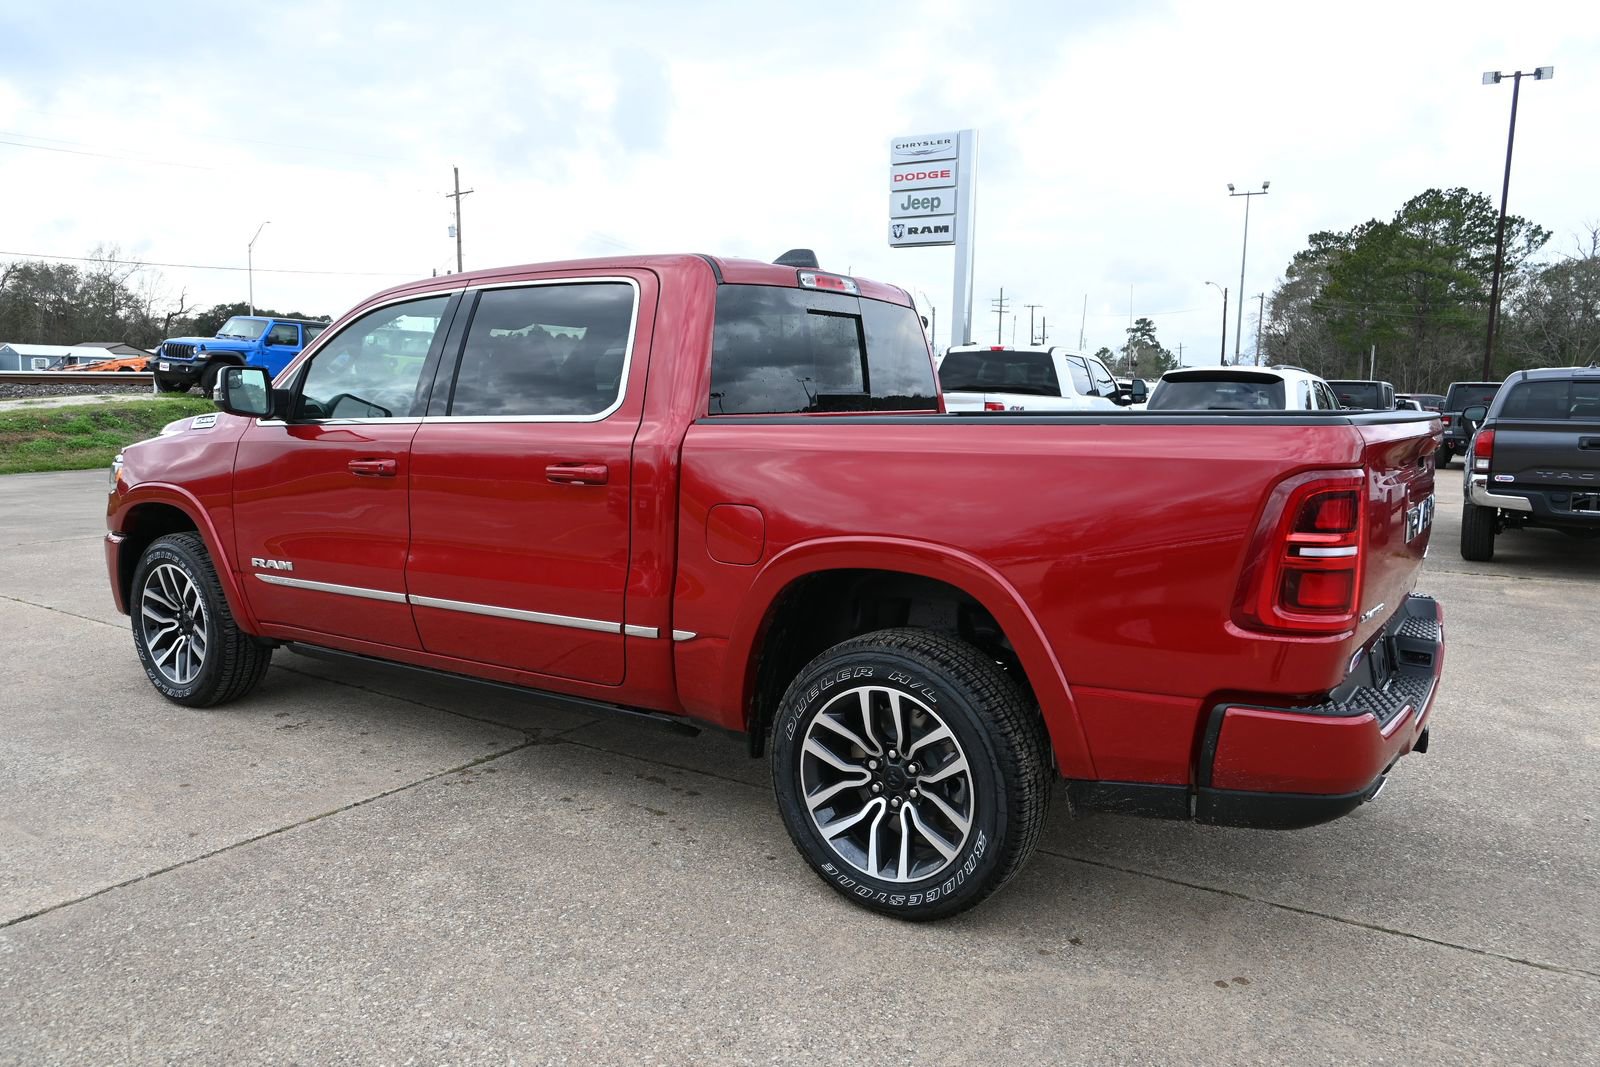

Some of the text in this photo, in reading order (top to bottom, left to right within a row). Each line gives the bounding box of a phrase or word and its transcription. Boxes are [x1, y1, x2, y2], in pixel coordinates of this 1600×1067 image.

[895, 138, 951, 150] CHRYSLER
[893, 169, 951, 182] DODGE
[900, 194, 942, 212] Jeep
[907, 224, 950, 235] RAM
[251, 557, 293, 571] RAM
[785, 666, 937, 741] DUELER H/L
[820, 829, 988, 906] BRIDGESTONE
